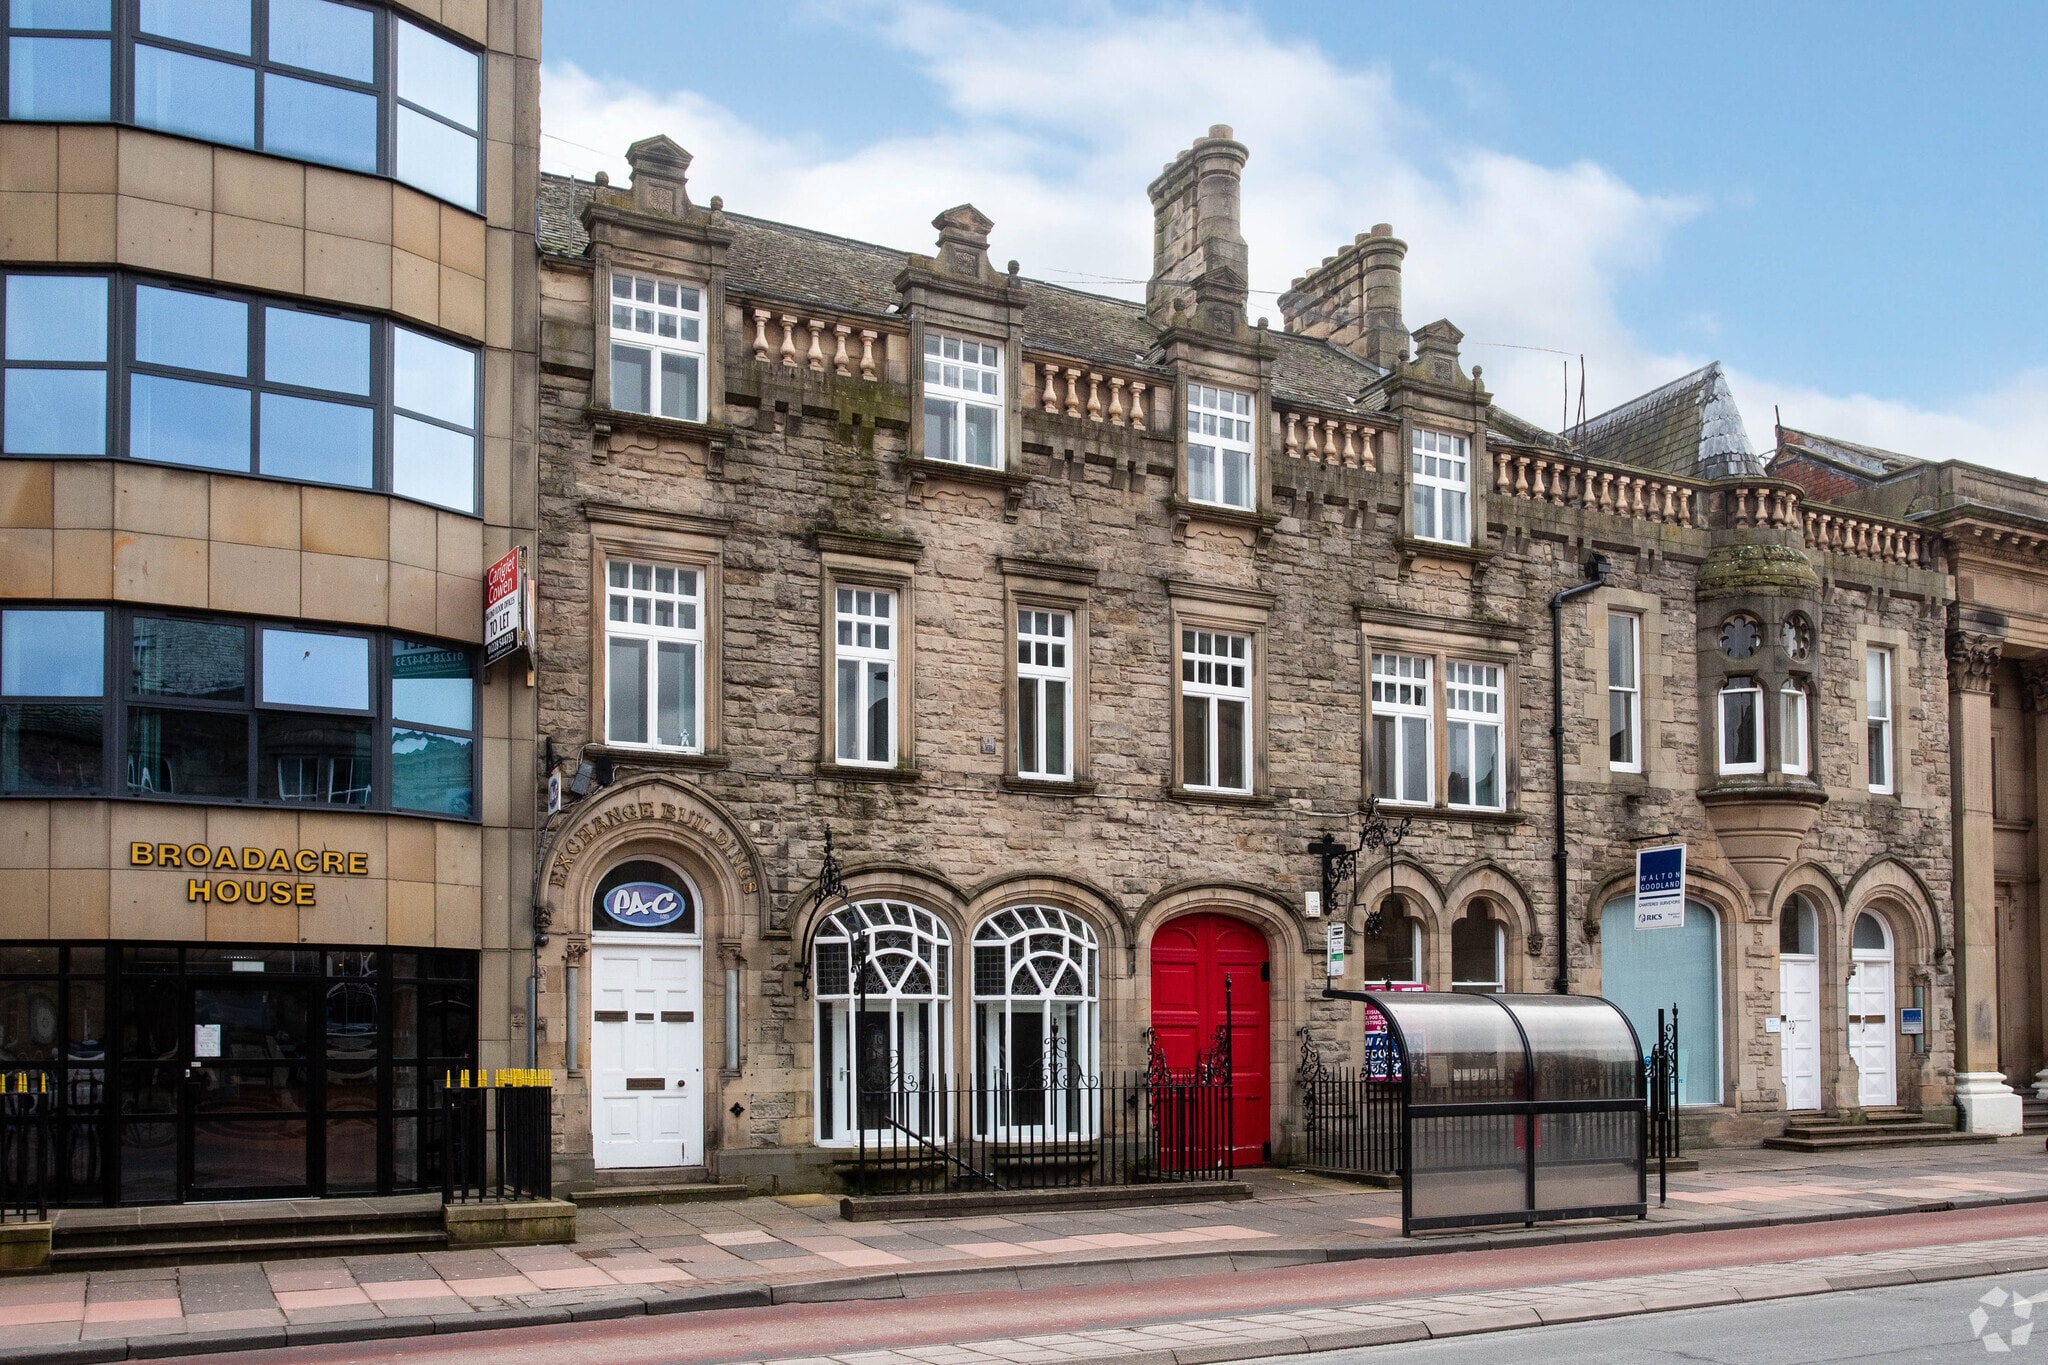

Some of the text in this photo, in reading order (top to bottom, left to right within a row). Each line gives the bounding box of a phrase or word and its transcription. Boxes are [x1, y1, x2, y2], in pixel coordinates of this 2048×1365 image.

[488, 553, 515, 586] Carigiet
[488, 577, 513, 604] Cowen
[490, 610, 510, 637] TO LET
[130, 841, 369, 875] BROADACRE
[549, 801, 758, 895] EXCHANGE BUILDINGS
[1640, 872, 1680, 881] WALTON
[1640, 881, 1680, 891] GOODLAND
[187, 878, 317, 906] HOUSE
[613, 889, 677, 916] PAC
